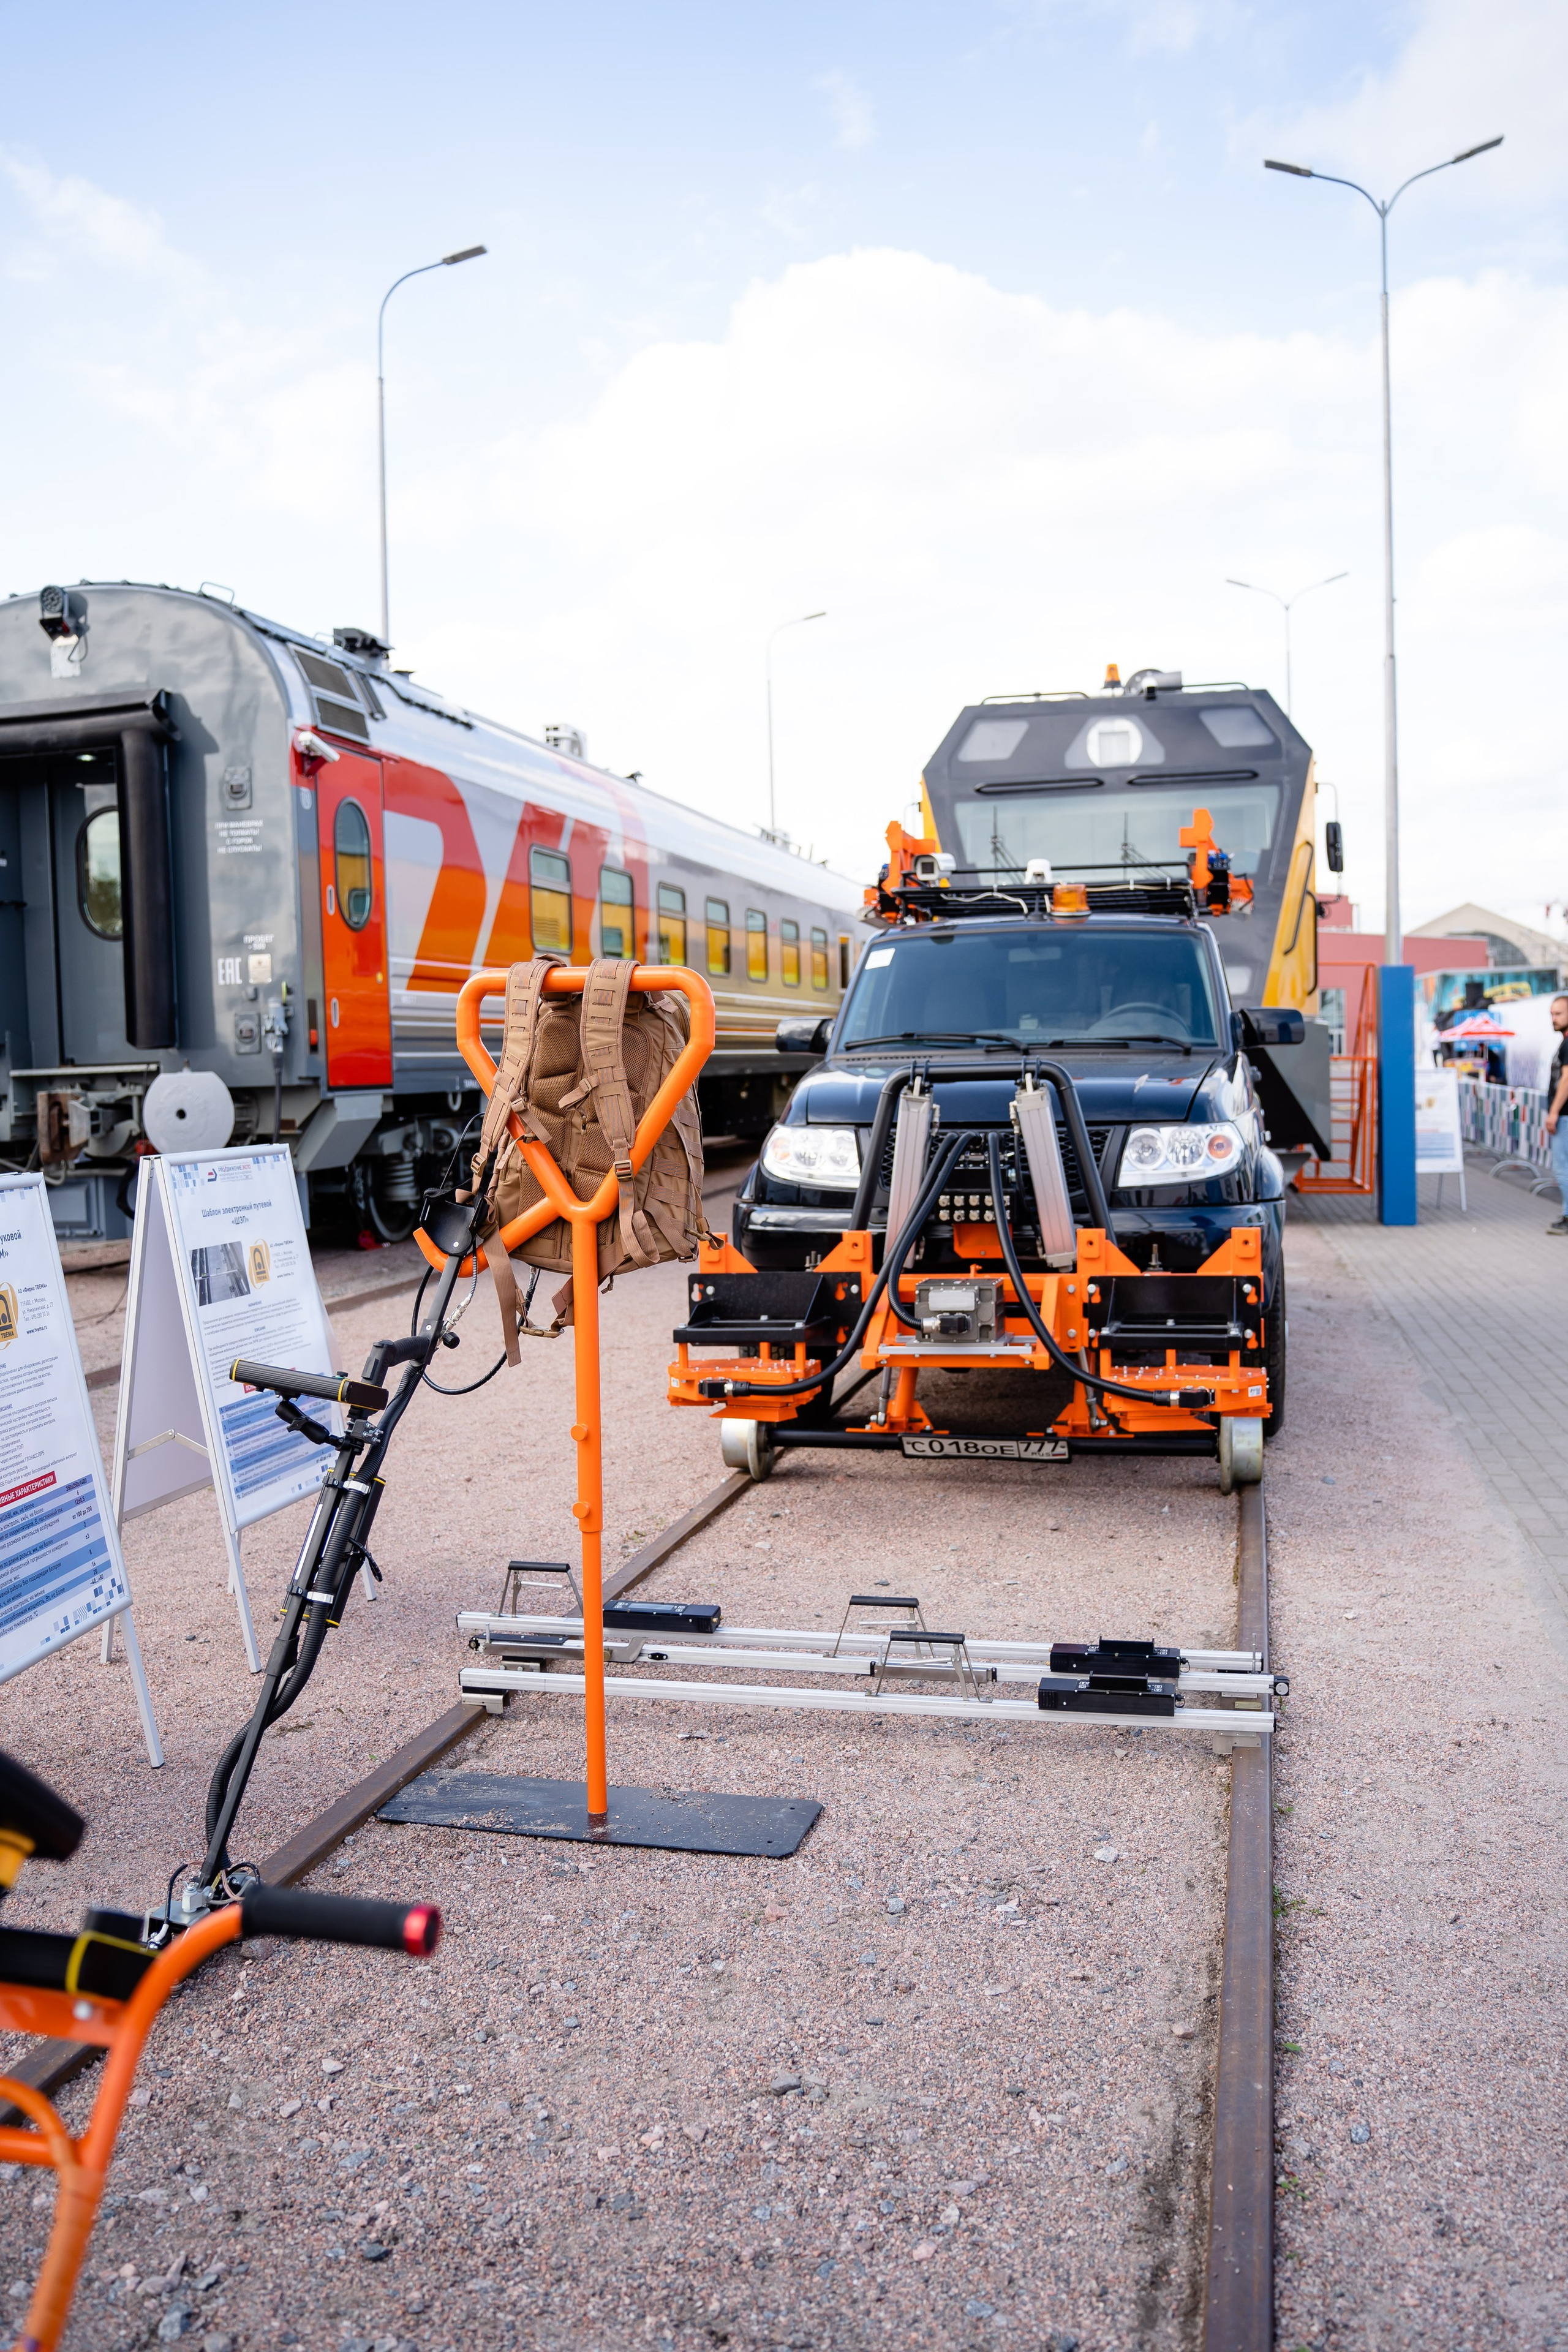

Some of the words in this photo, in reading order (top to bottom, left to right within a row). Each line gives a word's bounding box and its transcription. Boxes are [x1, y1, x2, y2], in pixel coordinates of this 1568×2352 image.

[243, 933, 274, 944] ПРОБЕГ
[202, 1207, 221, 1217] Шаблон
[222, 1202, 252, 1216] электронный
[254, 1199, 272, 1211] путевой
[232, 1215, 249, 1225] «ШЭП»
[0, 1229, 22, 1245] уковой
[1, 1330, 14, 1339] ТВЕМА
[26, 1324, 48, 1335] www.tvema.ru
[1020, 1441, 1059, 1453] 777
[15, 1474, 54, 1498] ХАРАКТЕРИСТИКИ
[3, 1518, 20, 1531] контроля,
[7, 1536, 21, 1548] размаха
